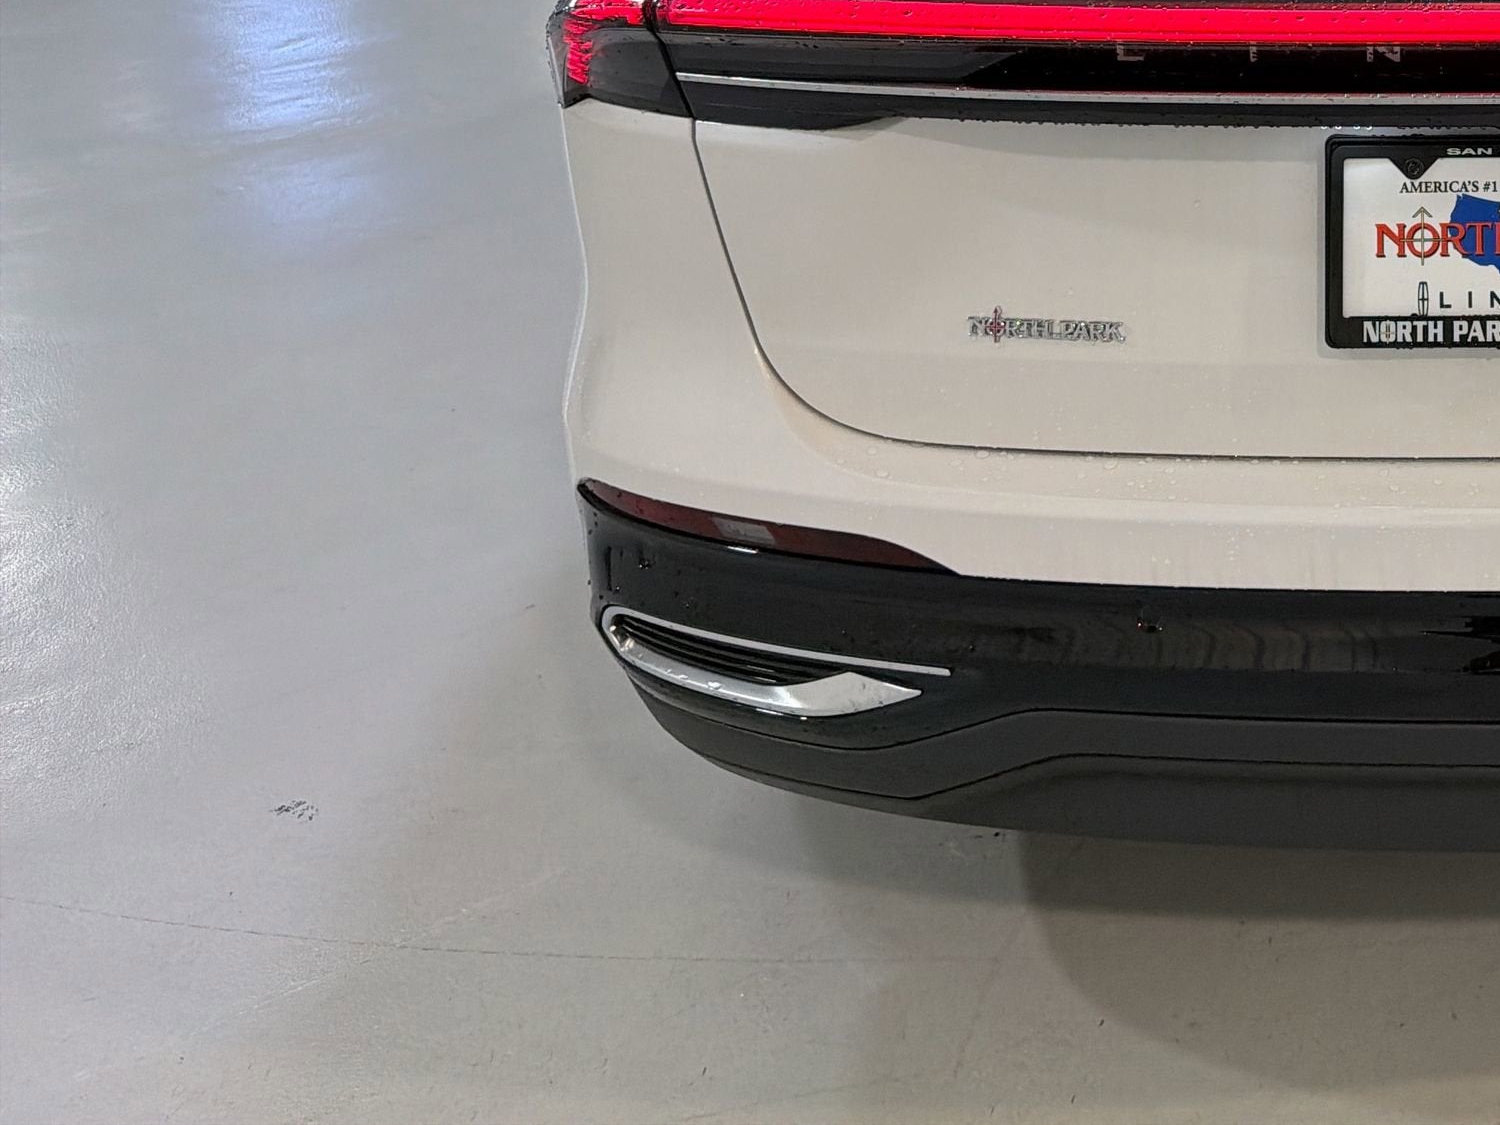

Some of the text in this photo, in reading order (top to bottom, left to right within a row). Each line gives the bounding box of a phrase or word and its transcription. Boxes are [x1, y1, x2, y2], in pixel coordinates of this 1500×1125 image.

[1446, 146, 1493, 156] SAN
[1399, 180, 1479, 194] AMERICA'S
[1482, 180, 1498, 193] #1
[1363, 320, 1444, 344] NORTH
